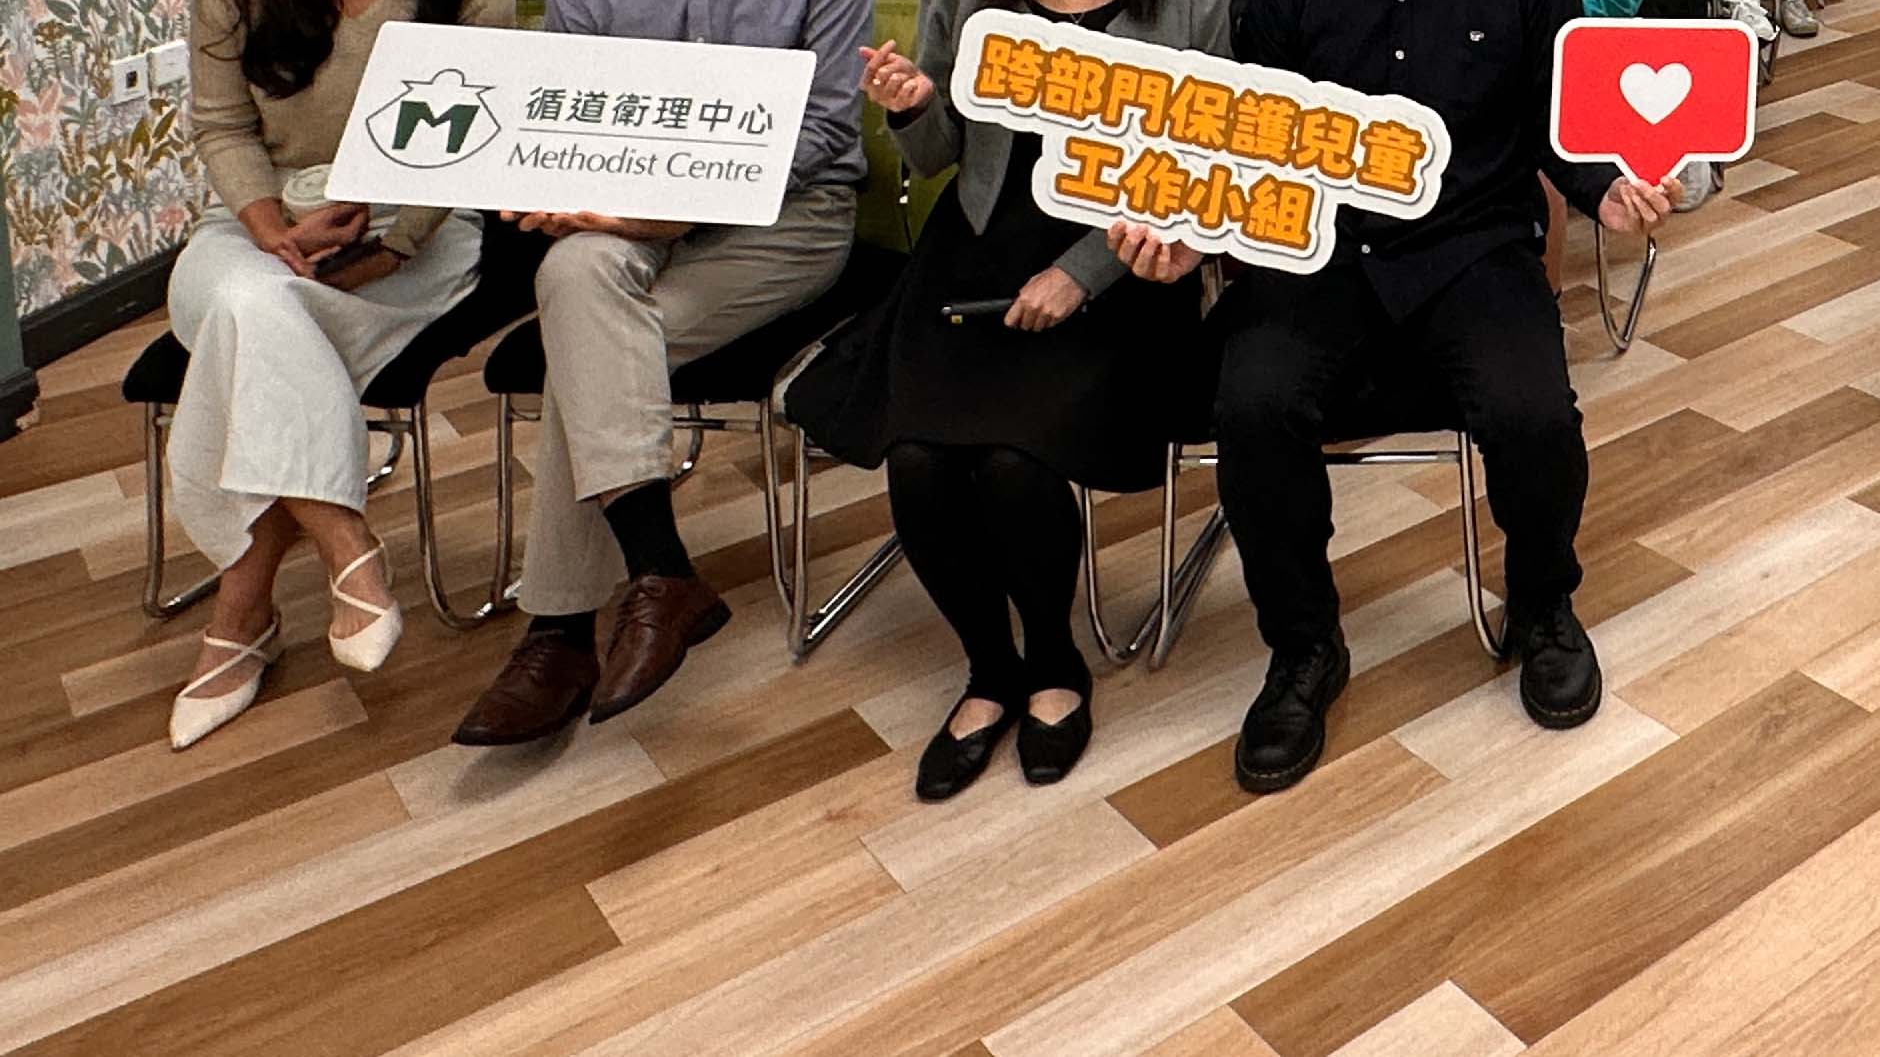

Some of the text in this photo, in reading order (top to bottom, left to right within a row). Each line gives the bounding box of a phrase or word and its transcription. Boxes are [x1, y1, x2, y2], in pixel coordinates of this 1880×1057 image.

[508, 142, 763, 182] Methodist Centre
[974, 33, 1426, 196] 跨部門保護兒童
[1054, 136, 1316, 251] 工作小組
